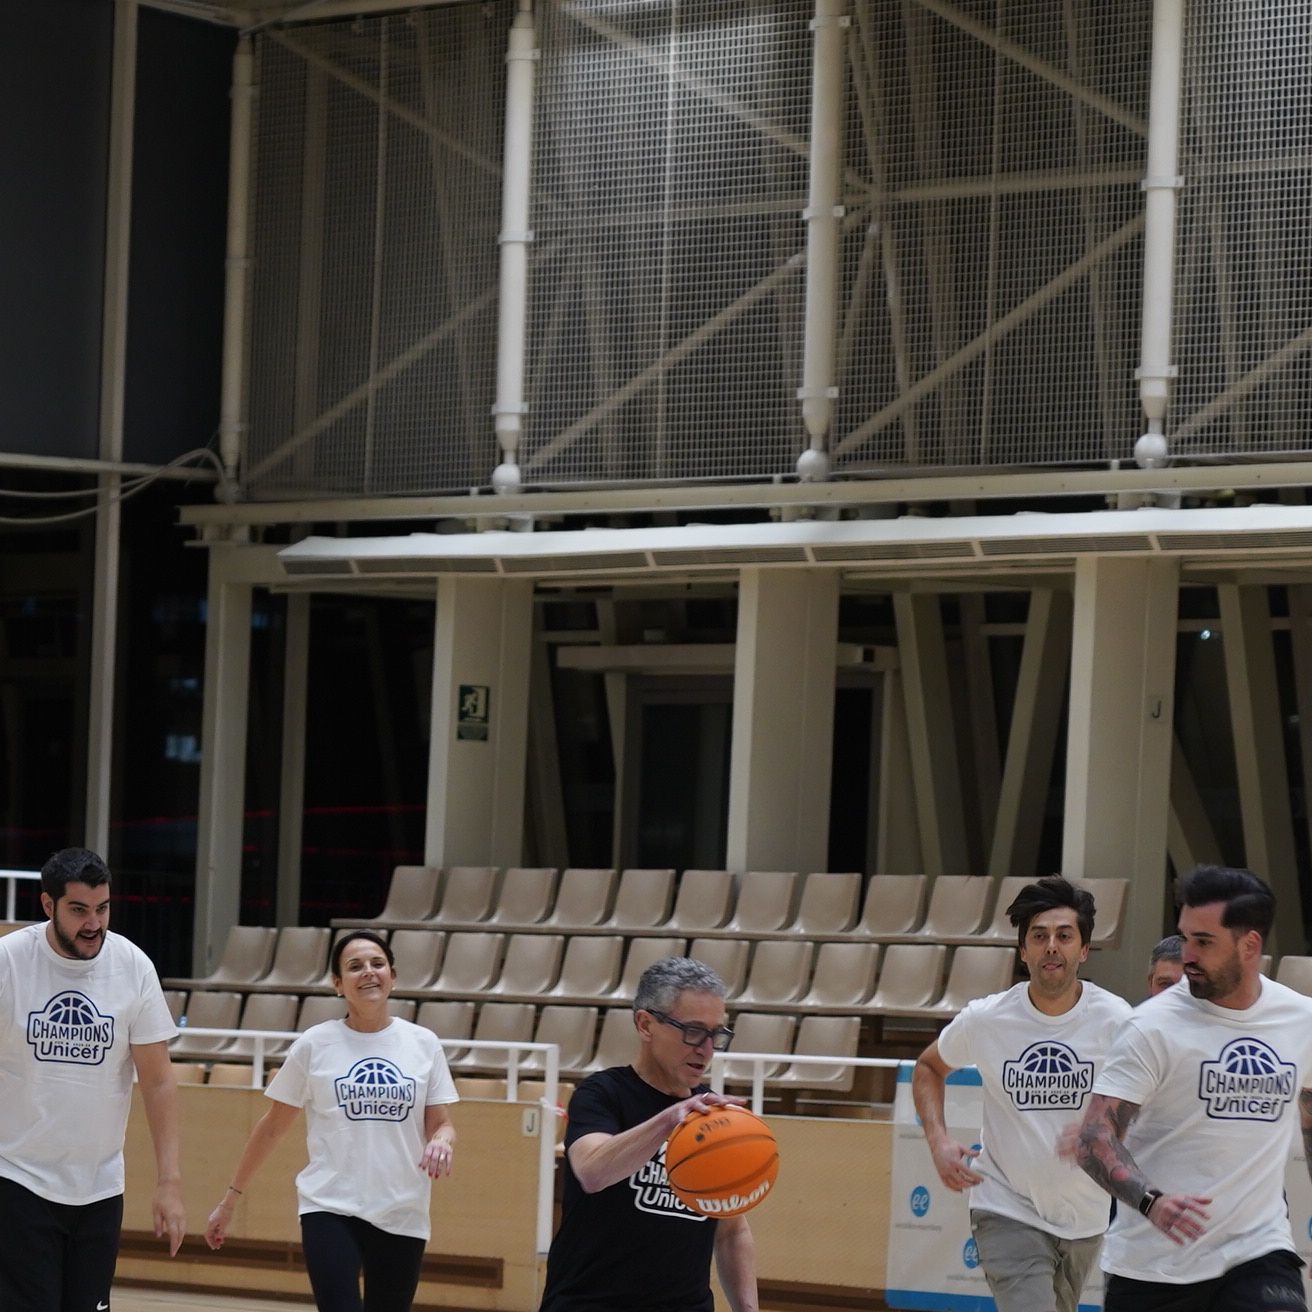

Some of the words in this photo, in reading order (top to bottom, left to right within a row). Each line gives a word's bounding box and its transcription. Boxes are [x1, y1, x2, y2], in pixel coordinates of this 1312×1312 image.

[1152, 700, 1162, 719] J
[32, 1018, 109, 1043] CHAMPIONS
[41, 1041, 99, 1059] Unicef
[1008, 1067, 1088, 1089] CHAMPIONS
[1206, 1070, 1292, 1095] CHAMPIONS
[340, 1083, 412, 1102] CHAMPIONS
[1016, 1091, 1078, 1105] Unicef
[351, 1101, 404, 1116] Unicef
[1213, 1097, 1280, 1114] Unicef
[526, 1113, 536, 1133] J
[643, 1186, 695, 1212] Unic
